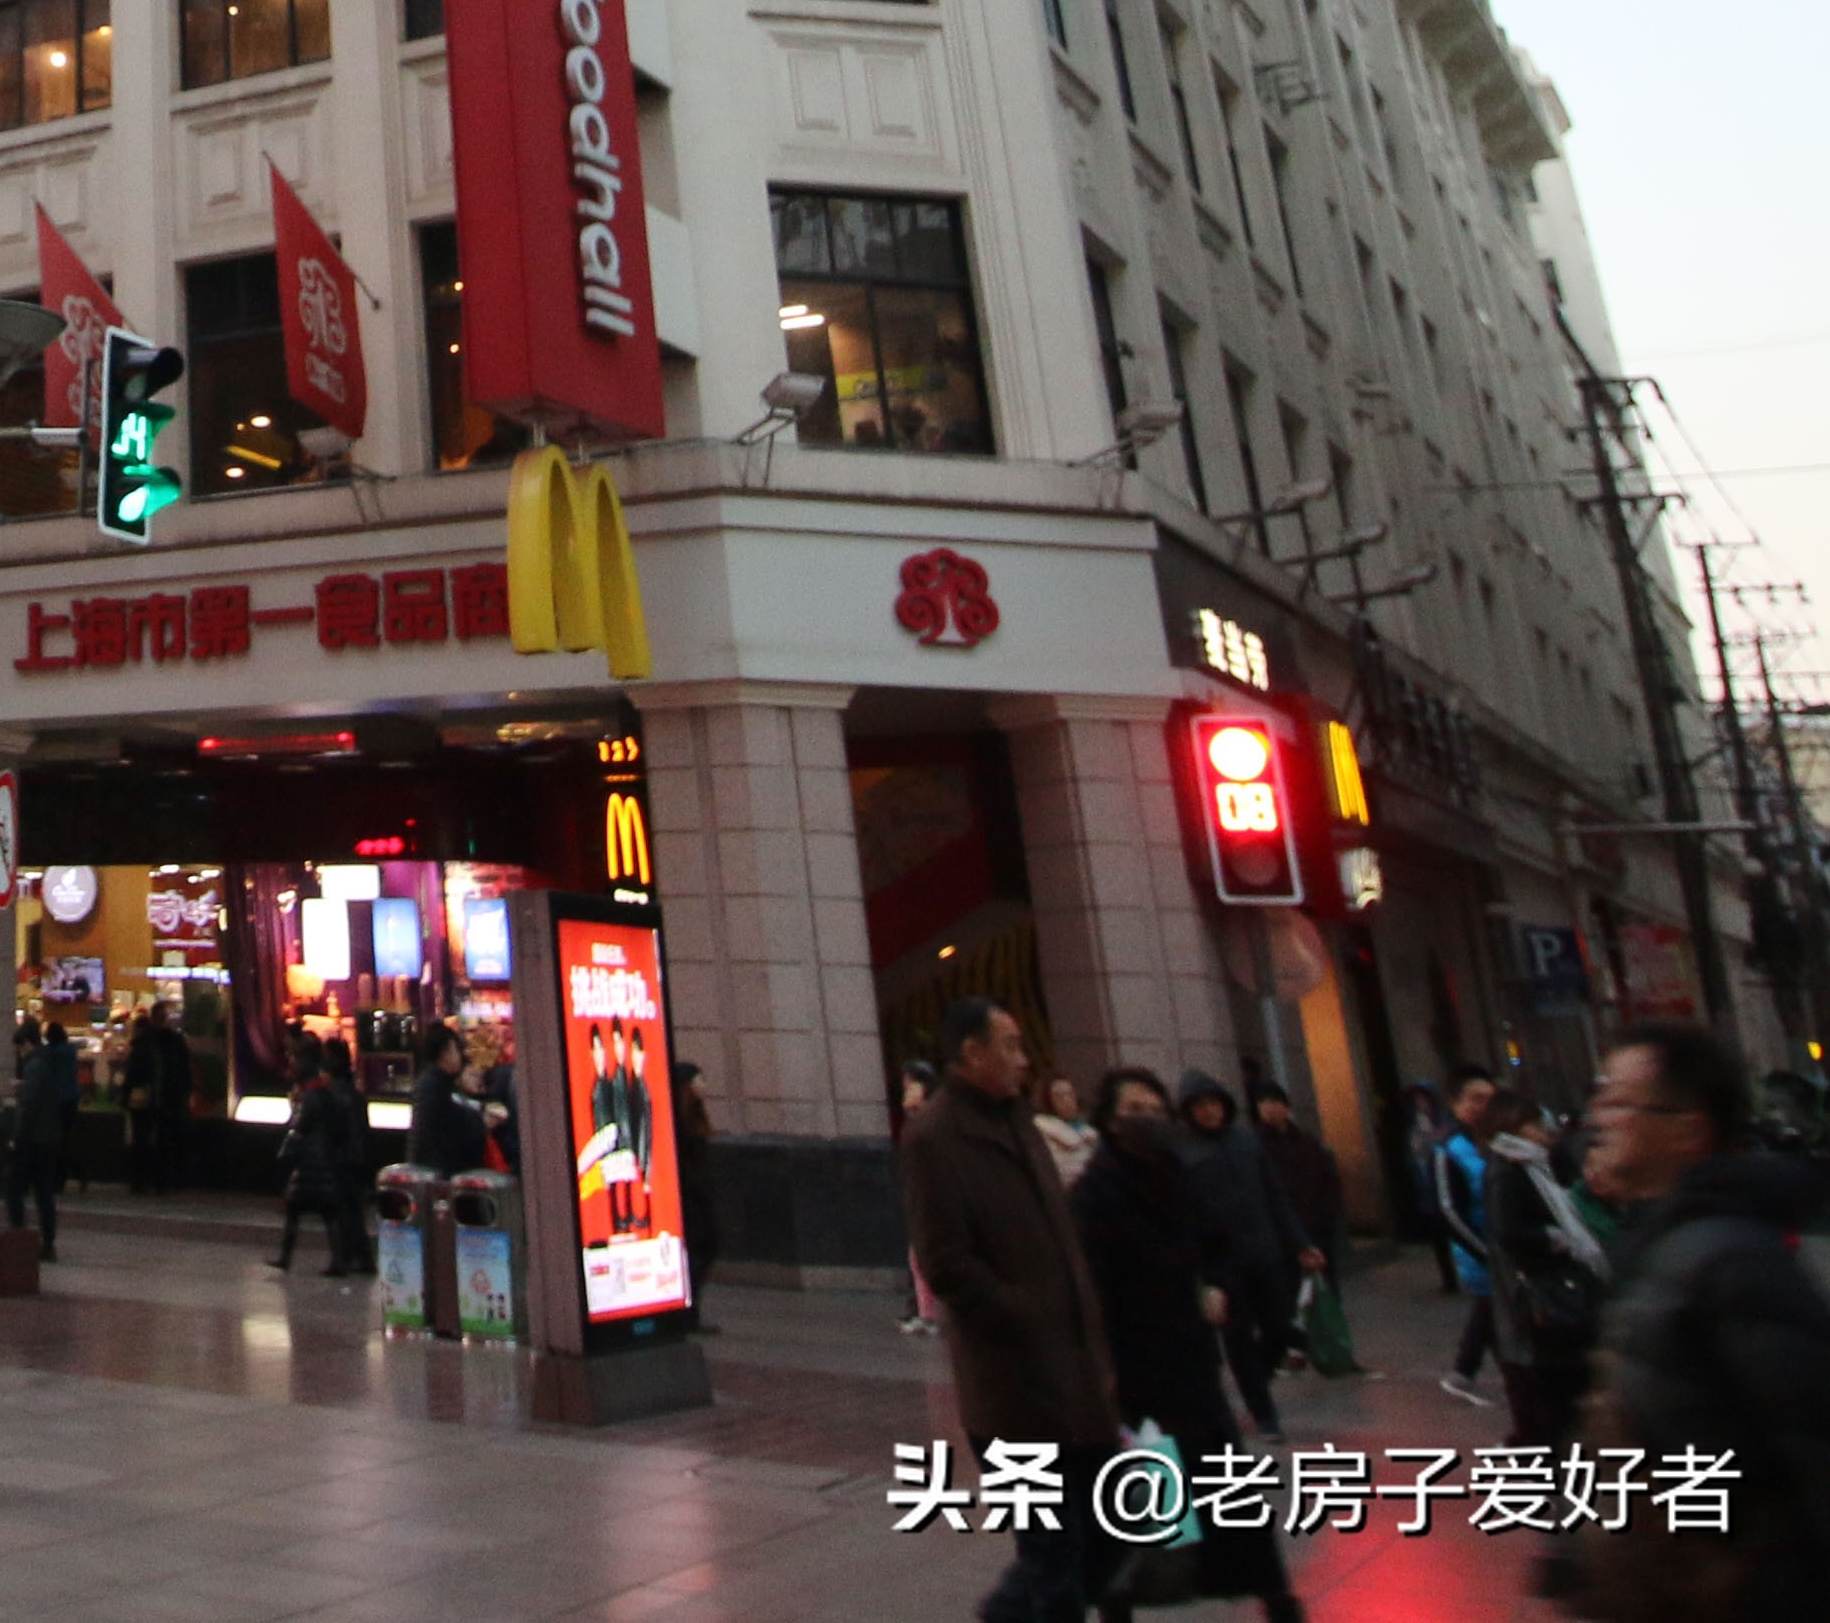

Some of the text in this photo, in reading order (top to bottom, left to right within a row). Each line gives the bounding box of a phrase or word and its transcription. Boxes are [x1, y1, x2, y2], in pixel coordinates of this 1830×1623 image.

[13, 561, 512, 673] 上海市第一食品商
[1531, 931, 1563, 976] P
